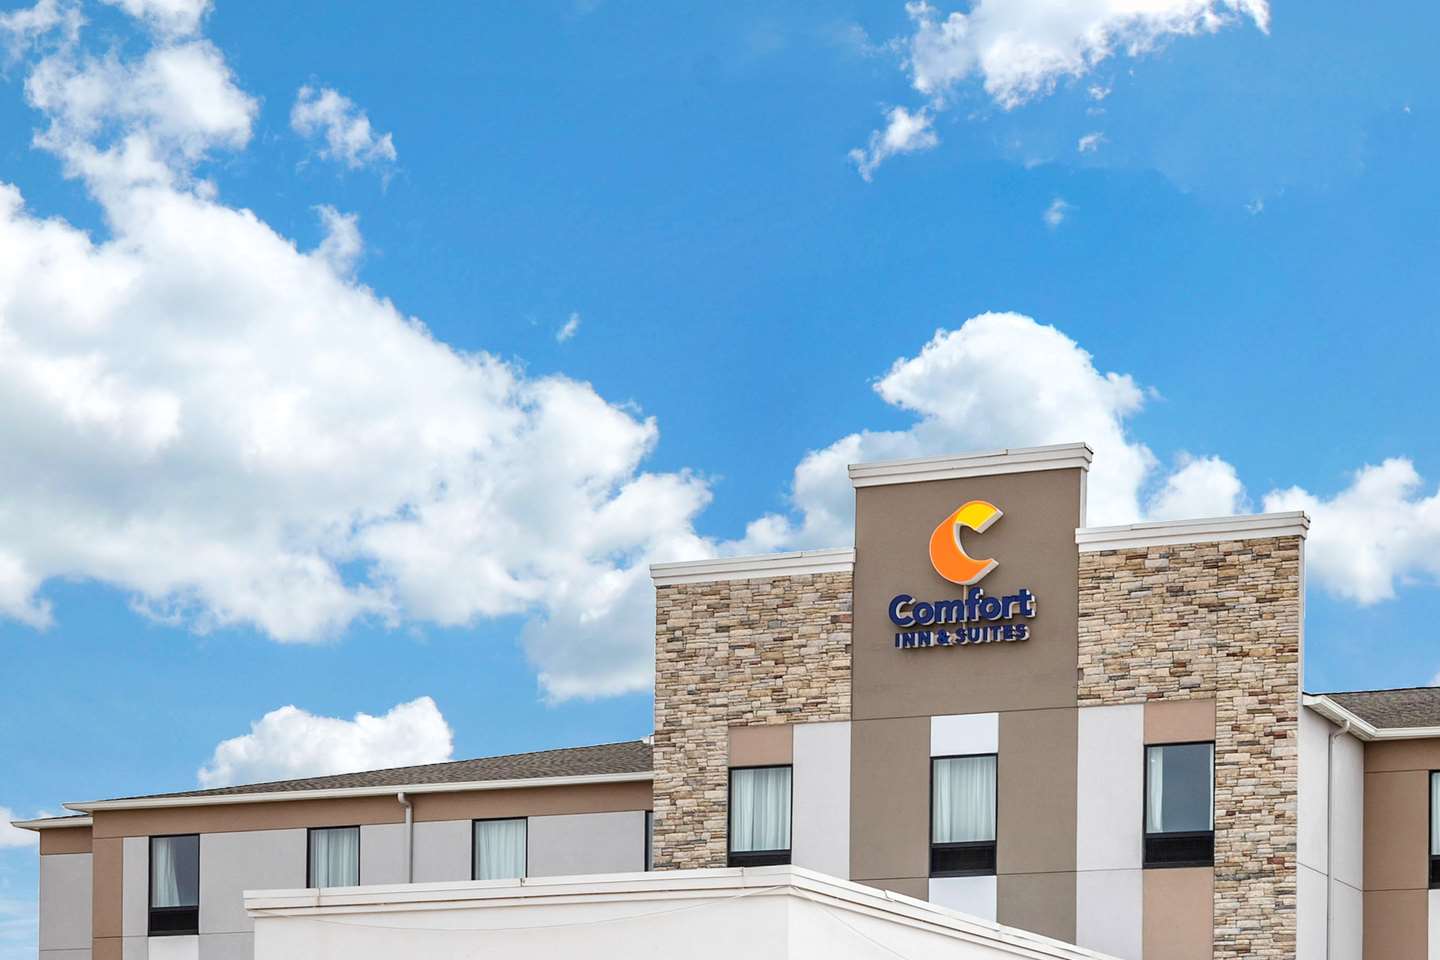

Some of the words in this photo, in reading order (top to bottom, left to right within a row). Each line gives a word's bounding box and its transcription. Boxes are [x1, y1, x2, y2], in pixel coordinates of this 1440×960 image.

[889, 587, 1037, 627] Comfort
[895, 631, 934, 649] INN
[936, 630, 955, 646] &
[957, 623, 1030, 645] SUITES
